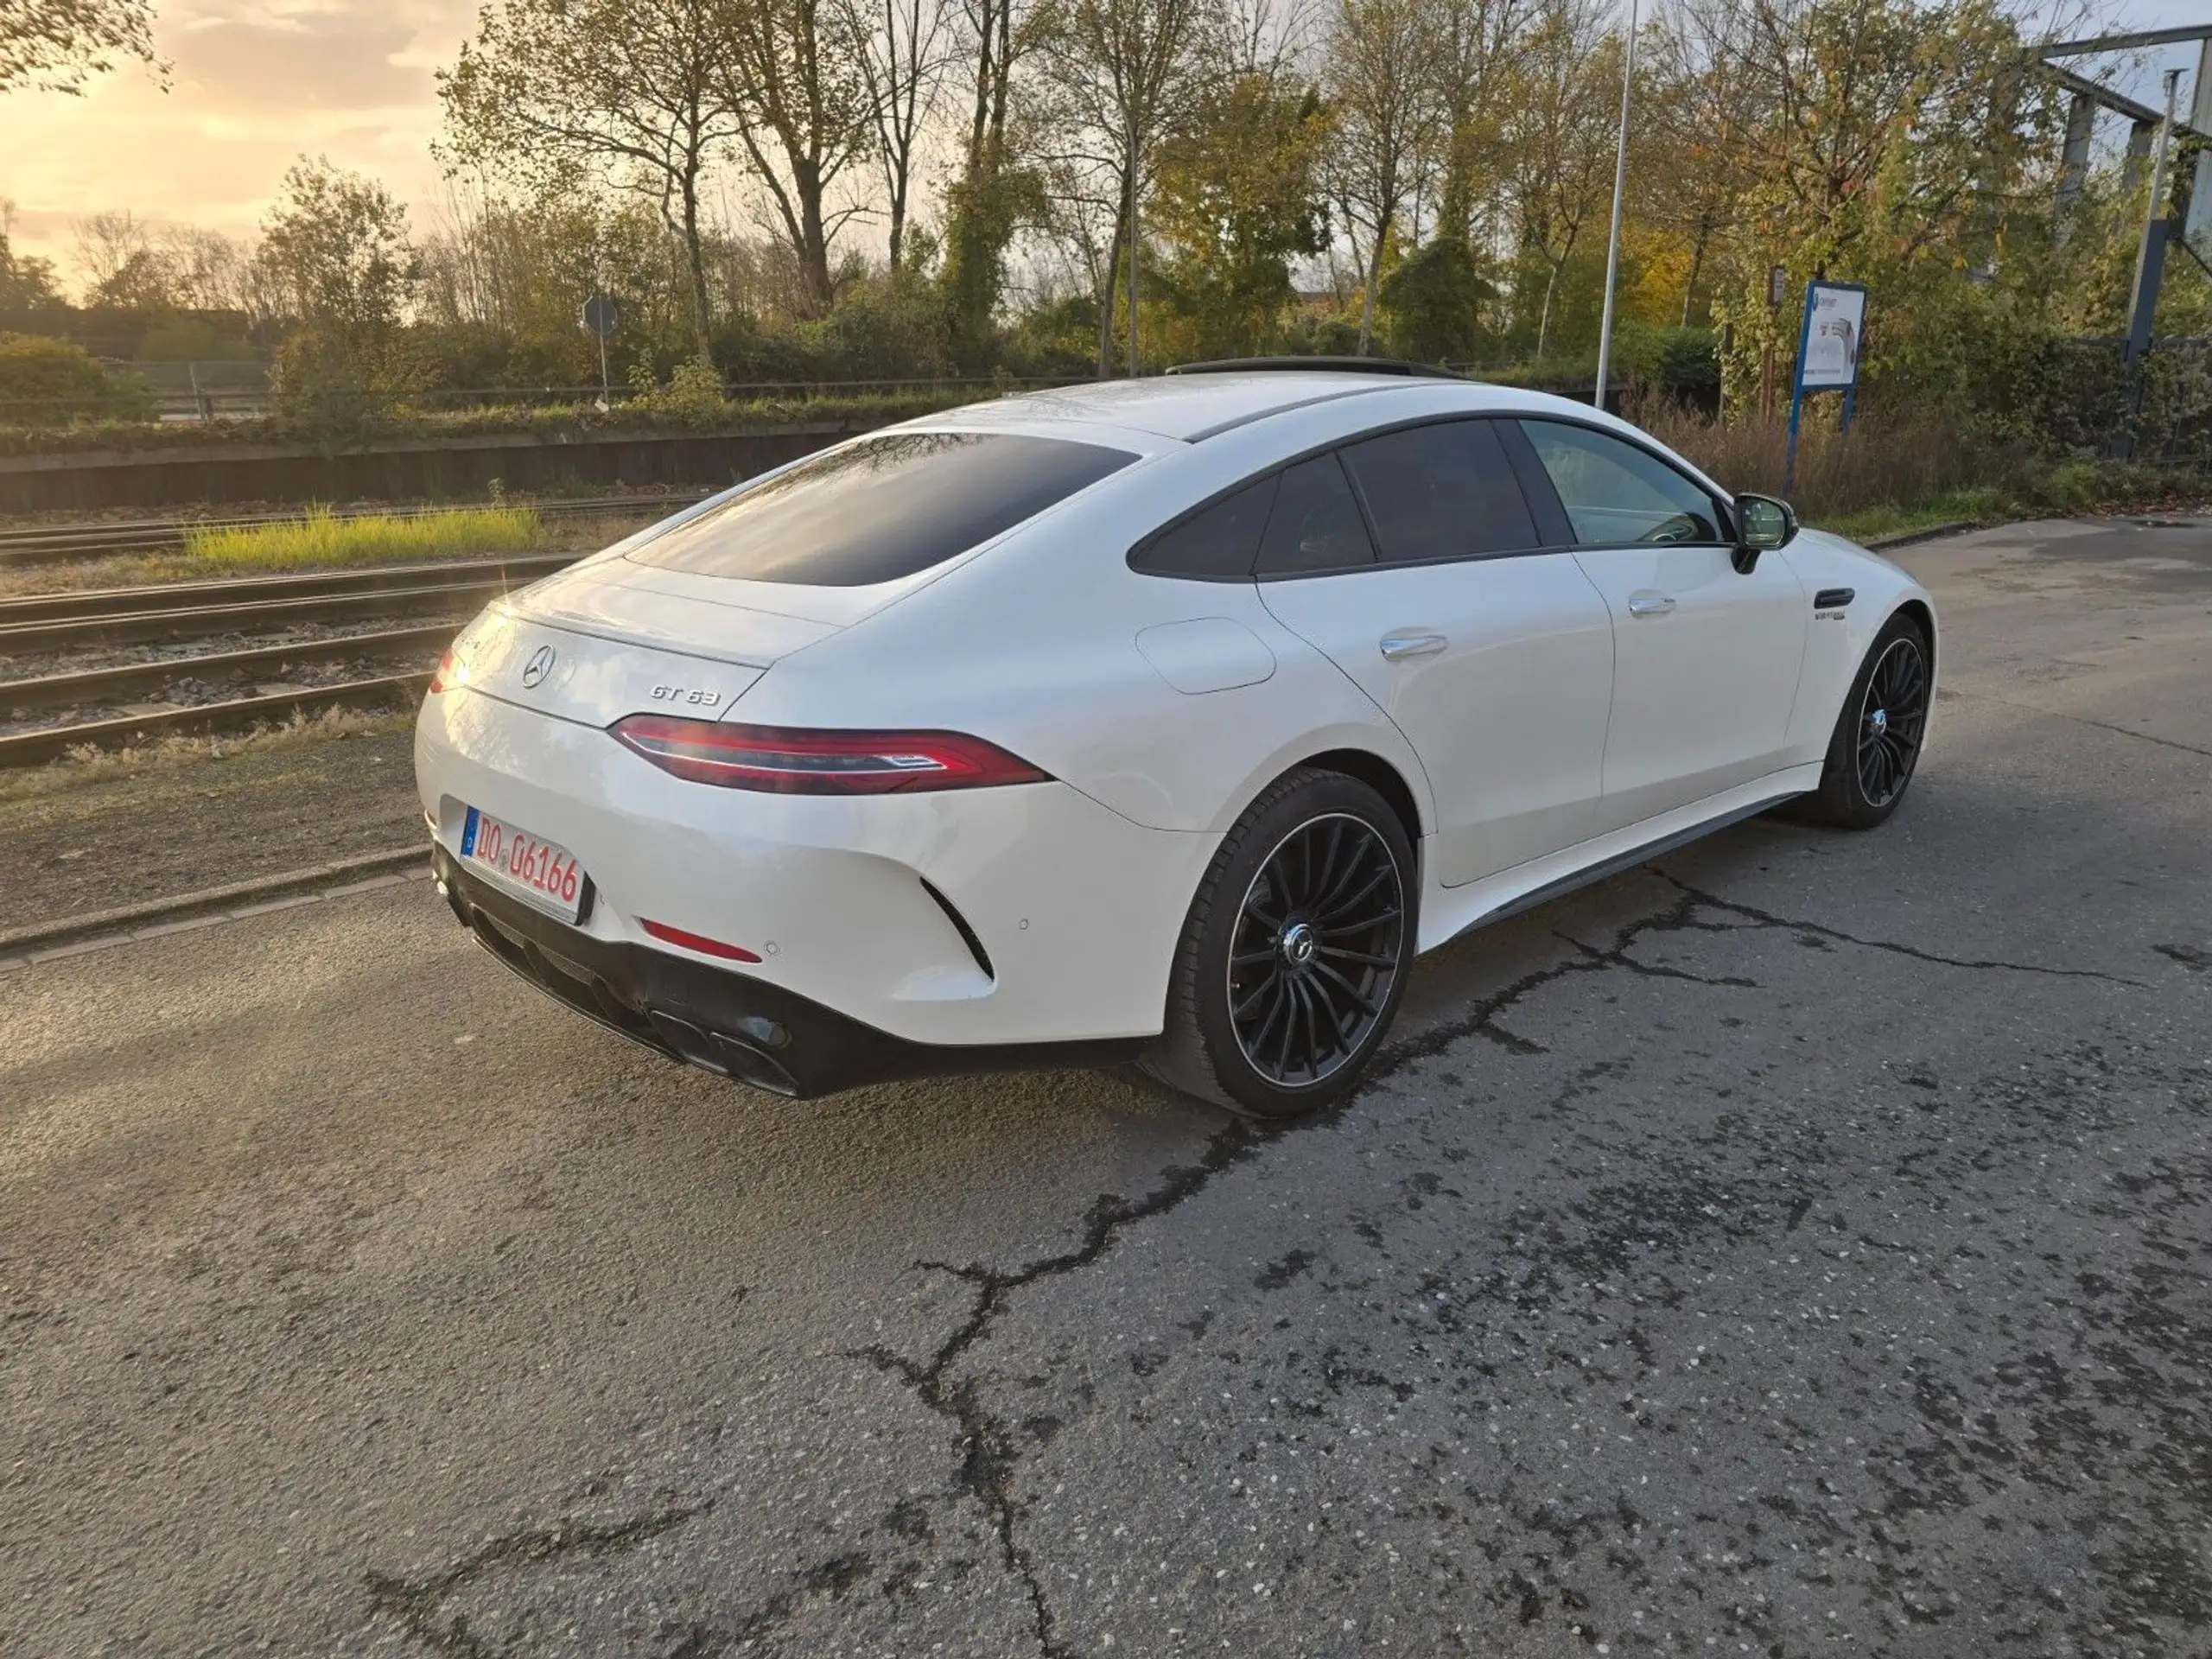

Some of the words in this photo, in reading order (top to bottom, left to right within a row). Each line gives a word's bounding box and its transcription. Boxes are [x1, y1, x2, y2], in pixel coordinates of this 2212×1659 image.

[651, 684, 683, 701] GT
[686, 689, 721, 706] 63
[477, 817, 501, 863] DO
[511, 835, 576, 902] 06166
